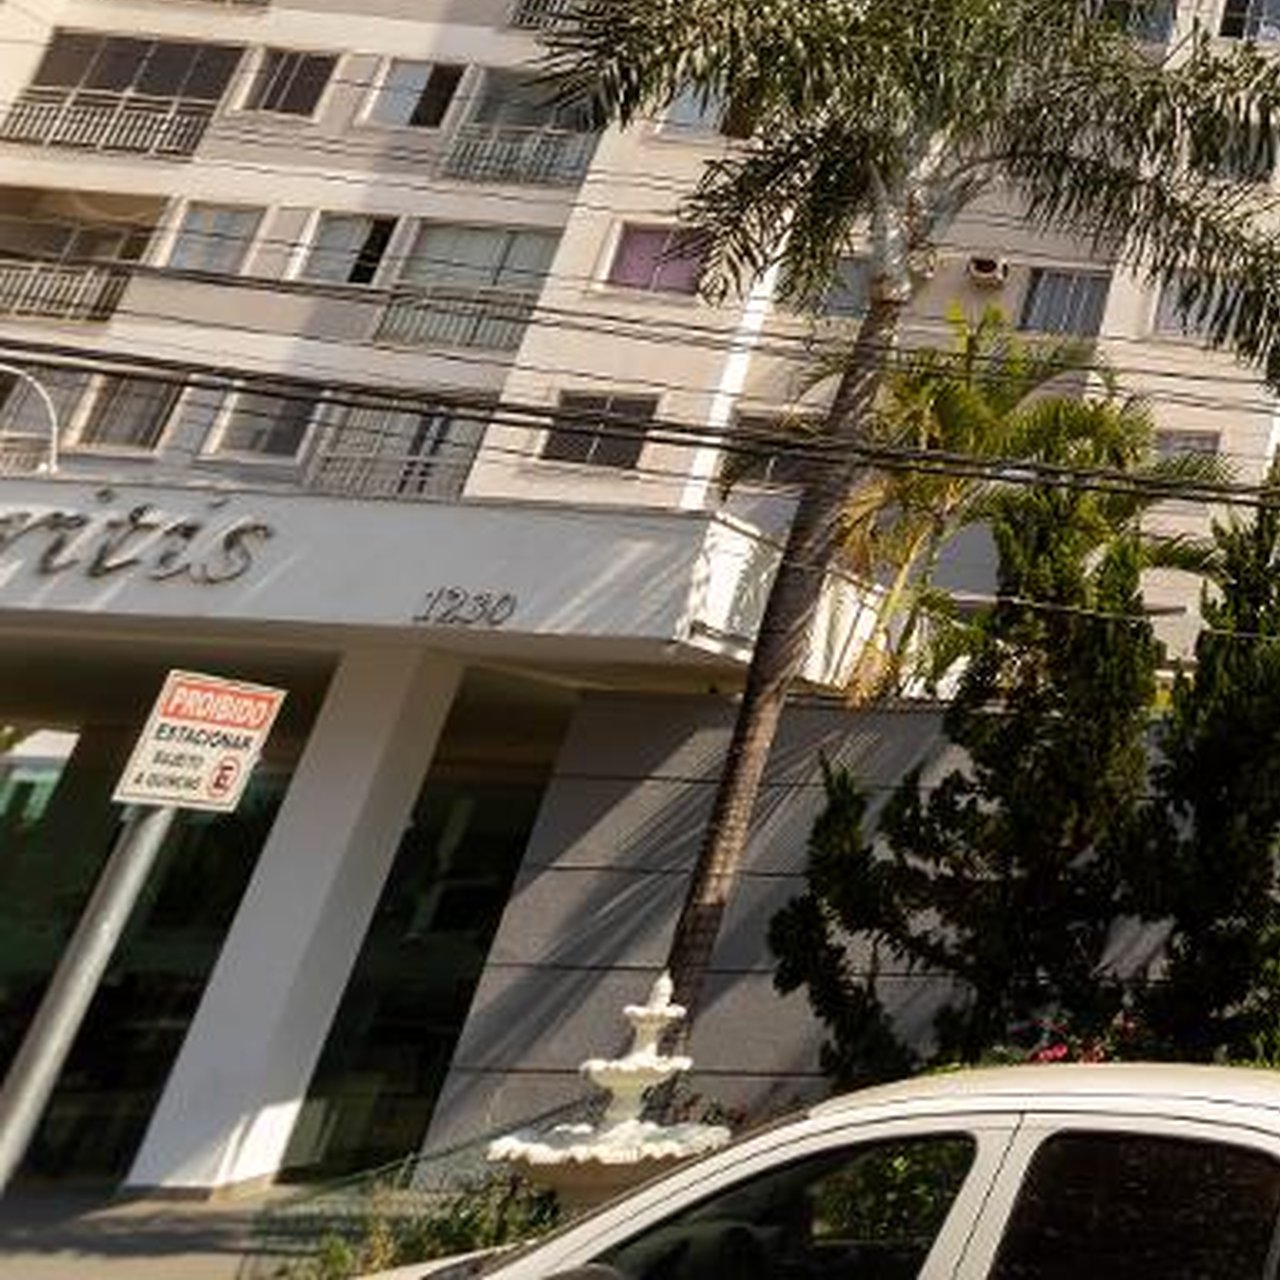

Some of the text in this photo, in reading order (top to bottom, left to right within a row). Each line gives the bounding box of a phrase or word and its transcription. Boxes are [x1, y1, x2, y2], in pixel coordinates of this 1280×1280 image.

[412, 586, 518, 626] 1230
[166, 686, 269, 725] PROIBIDO
[155, 723, 254, 749] ESTACIONAR
